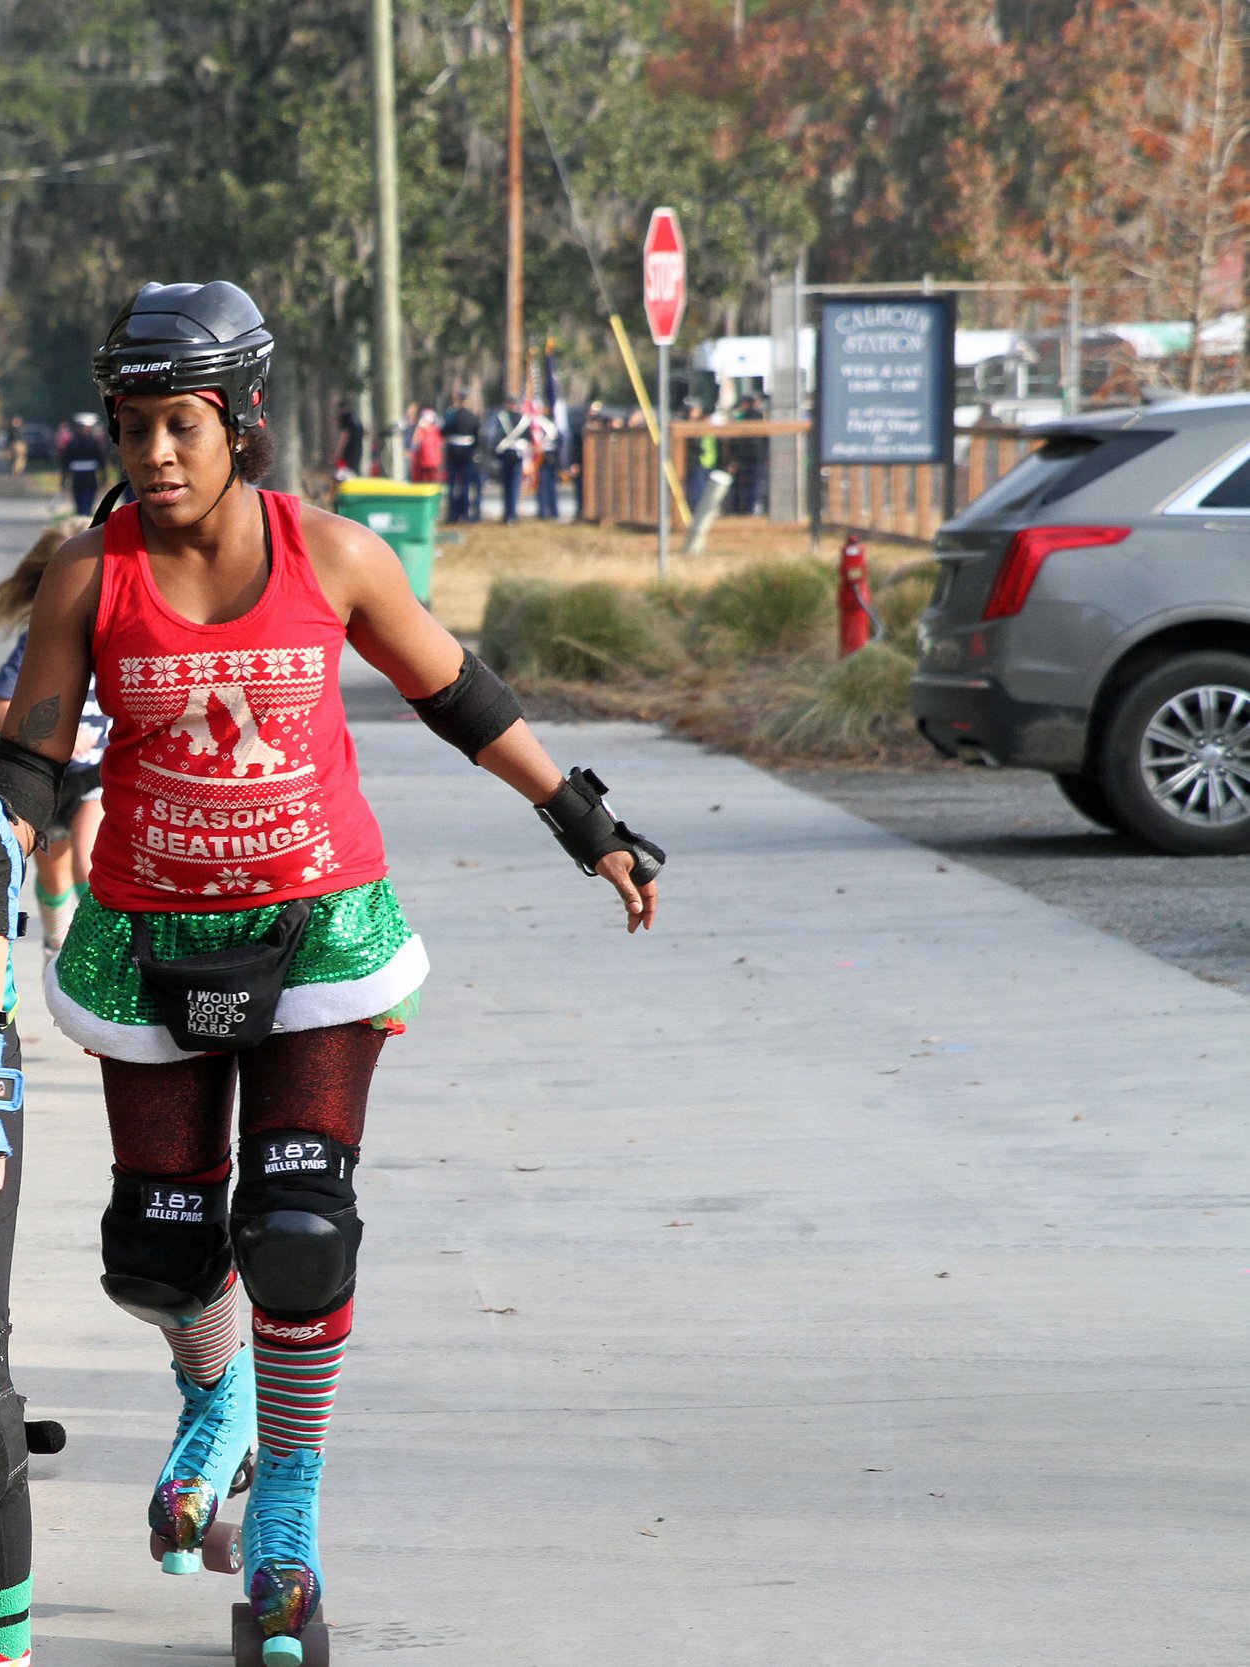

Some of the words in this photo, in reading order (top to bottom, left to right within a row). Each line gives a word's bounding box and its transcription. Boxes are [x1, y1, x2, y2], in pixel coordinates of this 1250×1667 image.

[648, 252, 684, 301] STOP
[835, 305, 930, 336] CALHOUN
[842, 333, 923, 354] STATION
[120, 361, 172, 374] BAUER
[147, 819, 310, 858] BEATINGS
[187, 990, 192, 1000] I
[197, 991, 250, 1004] WOULD
[188, 1010, 218, 1024] YOU
[224, 1012, 246, 1024] SO
[187, 1020, 229, 1034] HARD
[268, 1143, 323, 1161] 187
[264, 1160, 300, 1174] KILLER
[301, 1160, 328, 1170] PADS
[151, 1191, 203, 1210] 187
[145, 1208, 179, 1220] KILLER
[180, 1211, 203, 1222] PADS
[258, 1322, 328, 1342] SCABS
